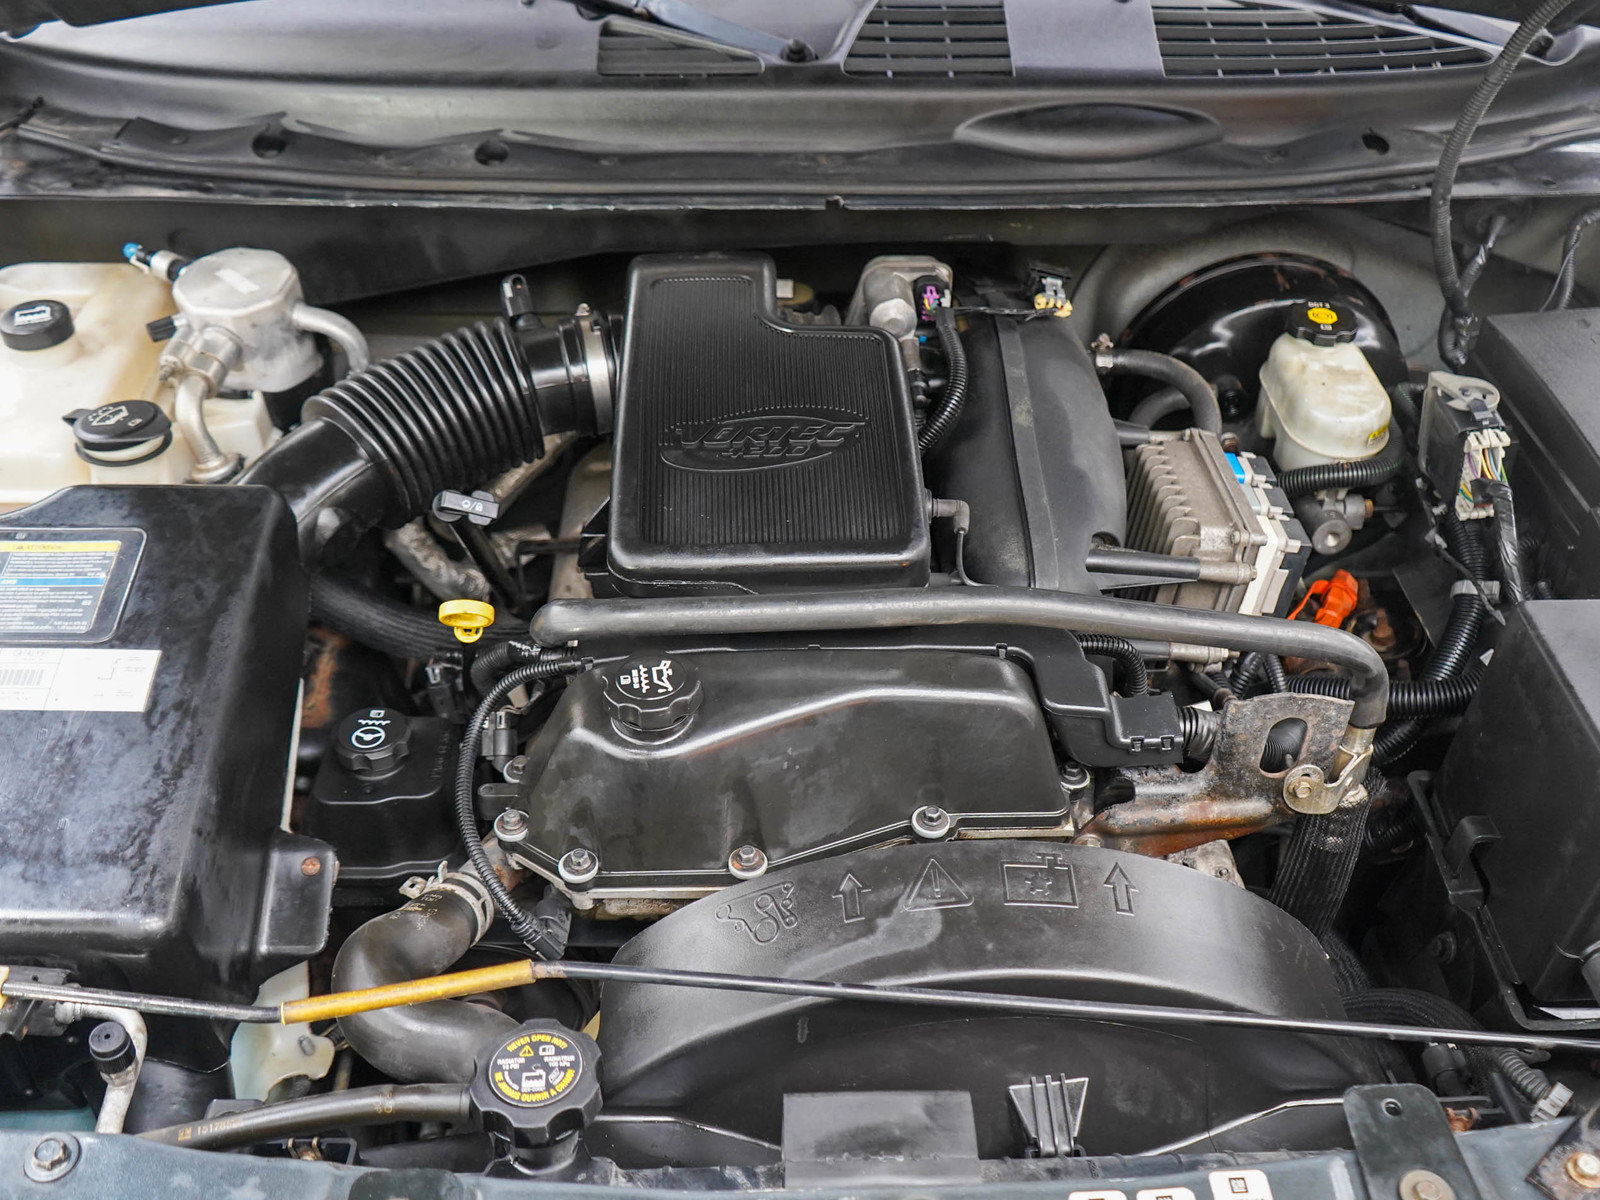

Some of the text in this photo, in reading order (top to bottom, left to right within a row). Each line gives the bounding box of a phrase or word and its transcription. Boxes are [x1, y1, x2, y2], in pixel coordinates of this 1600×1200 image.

[676, 423, 856, 448] VORTEC
[716, 446, 811, 458] 4200
[507, 1037, 530, 1052] NEVER
[521, 1091, 549, 1101] OUVRIR
